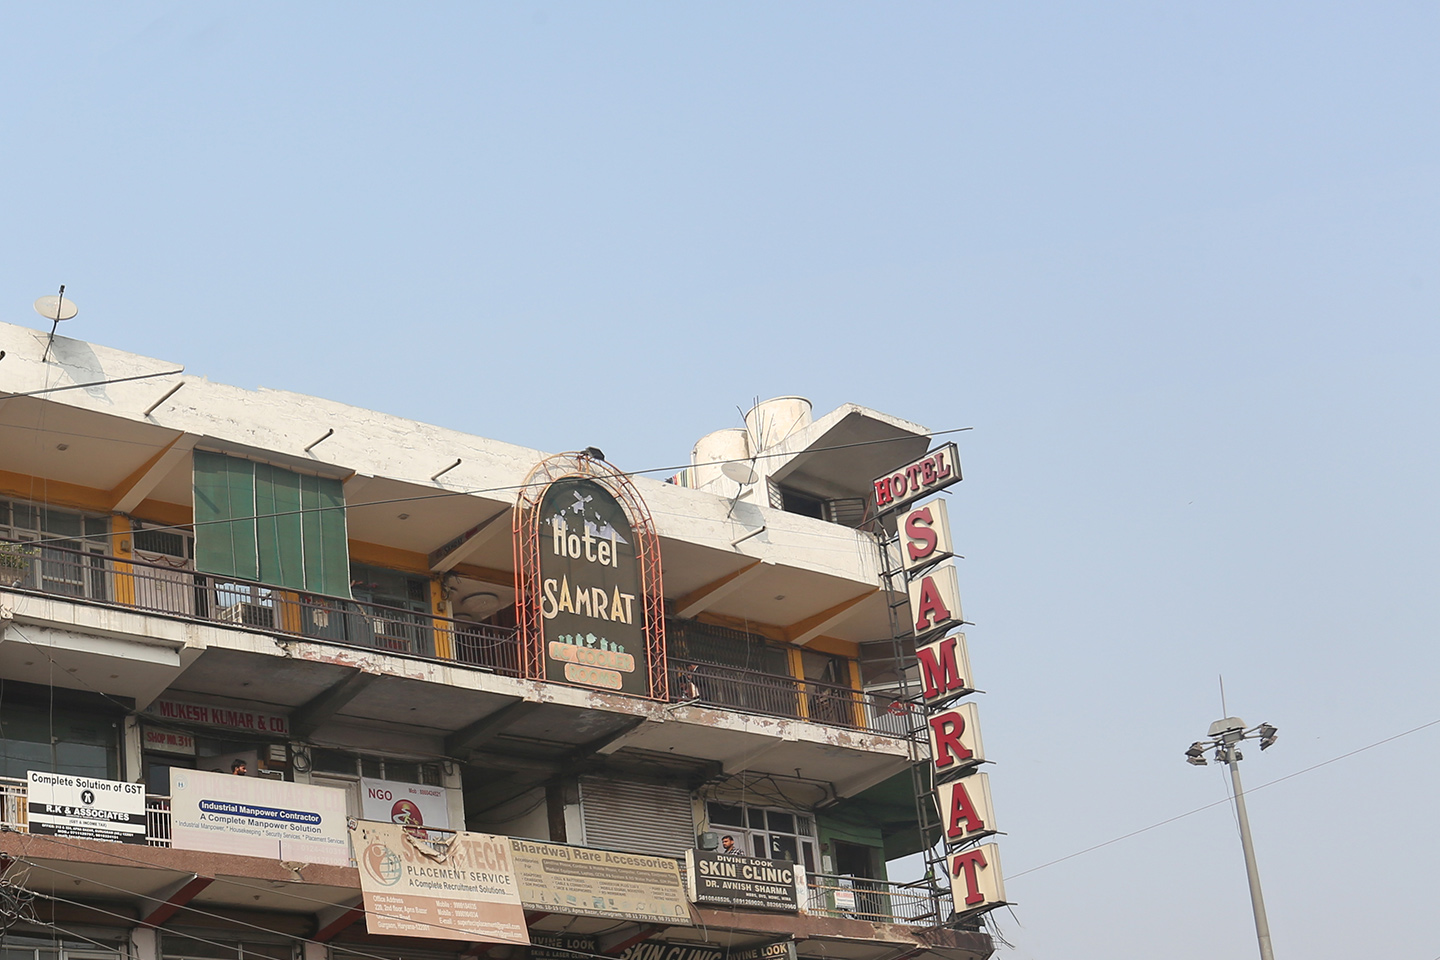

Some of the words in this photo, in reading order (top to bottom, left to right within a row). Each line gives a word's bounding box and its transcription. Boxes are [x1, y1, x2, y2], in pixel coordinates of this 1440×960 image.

[874, 451, 951, 507] HOTEL
[553, 519, 618, 568] Hotel
[541, 574, 635, 625] SAMRAT
[552, 642, 568, 659] AC
[576, 648, 631, 671] COOLER
[160, 701, 208, 722] MUKESH
[212, 709, 254, 728] KUMAR
[270, 717, 287, 733] CO.
[904, 508, 988, 906] SAMRAT
[32, 773, 73, 786] Complete
[76, 779, 111, 791] Solution
[114, 784, 122, 792] of
[125, 785, 142, 794] GST
[368, 788, 392, 800] NGO
[46, 805, 62, 813] R.K
[74, 808, 129, 820] ASSOCIATES
[202, 801, 238, 812] Industrial
[240, 806, 278, 817] Manpower
[280, 811, 319, 822] Contractor
[208, 814, 245, 825] Complete
[248, 819, 287, 829] Manpower
[290, 824, 321, 833] Solution
[512, 840, 571, 862] Bhardwaj
[573, 850, 601, 863] Rare
[605, 853, 675, 870] Accessories
[717, 855, 747, 863] DIVINE
[407, 866, 466, 880] PLACEMENT
[470, 872, 510, 885] SERVICE
[700, 860, 736, 877] SKIN
[743, 865, 792, 883] CLINIC
[706, 880, 719, 888] DR.
[722, 882, 752, 891] AVNISH
[755, 885, 788, 895] SHARMA
